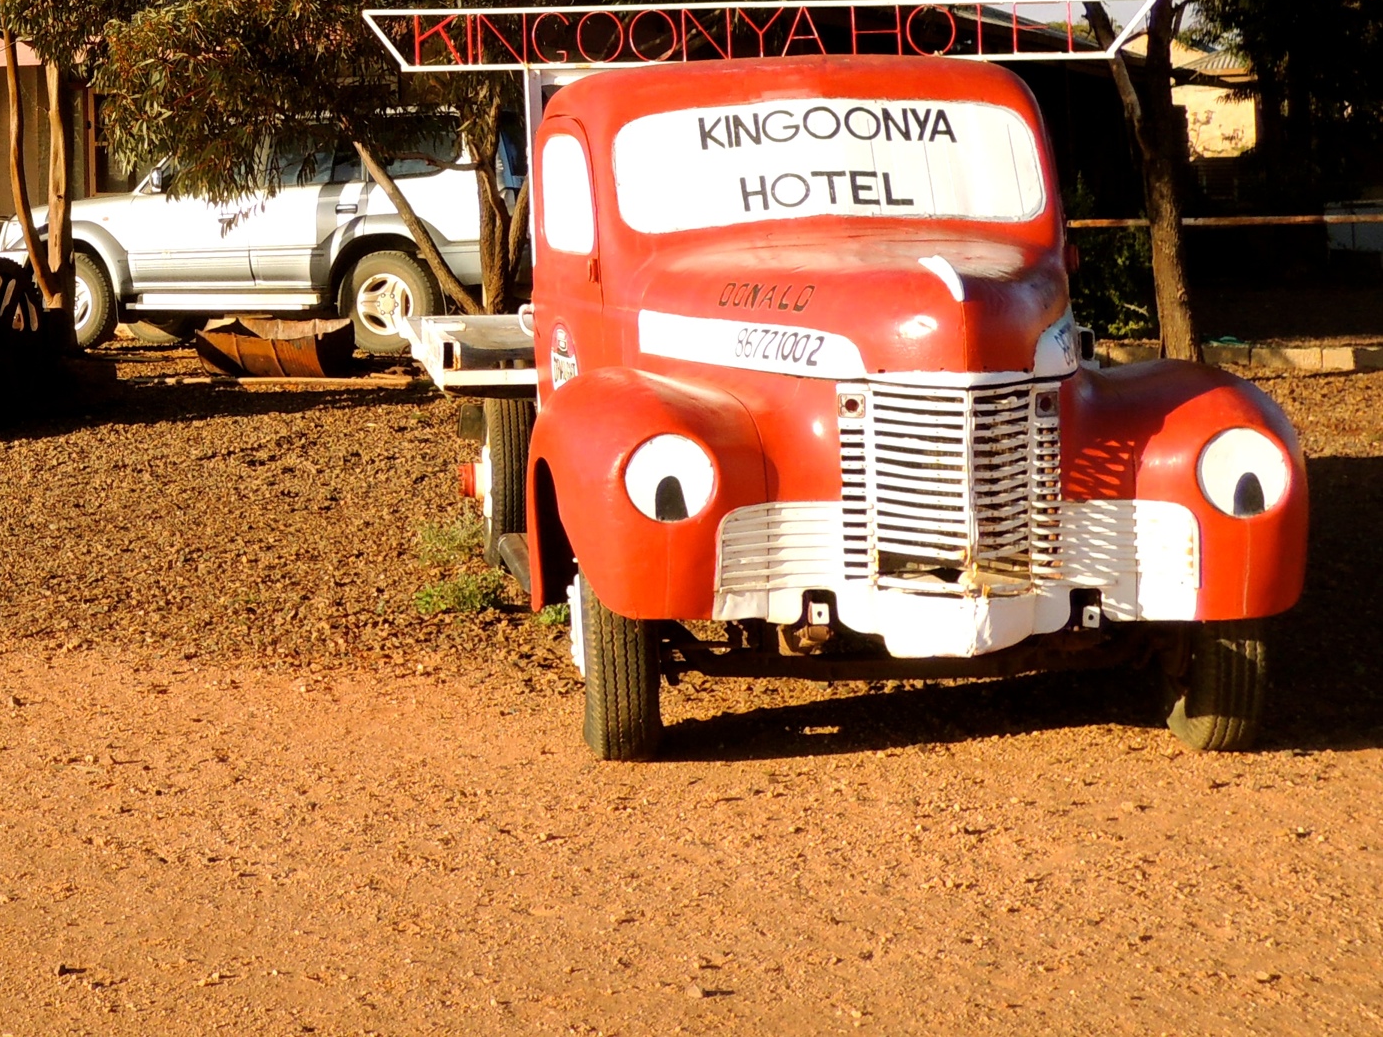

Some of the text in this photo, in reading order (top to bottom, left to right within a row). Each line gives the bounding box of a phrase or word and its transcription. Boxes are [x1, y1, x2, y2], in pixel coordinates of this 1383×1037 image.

[414, 1, 1109, 65] KINGOONYA HOTEL
[698, 106, 957, 150] KINGOONYA
[739, 170, 914, 212] HOTEL
[718, 283, 815, 312] DONALD
[735, 328, 825, 366] 86721002
